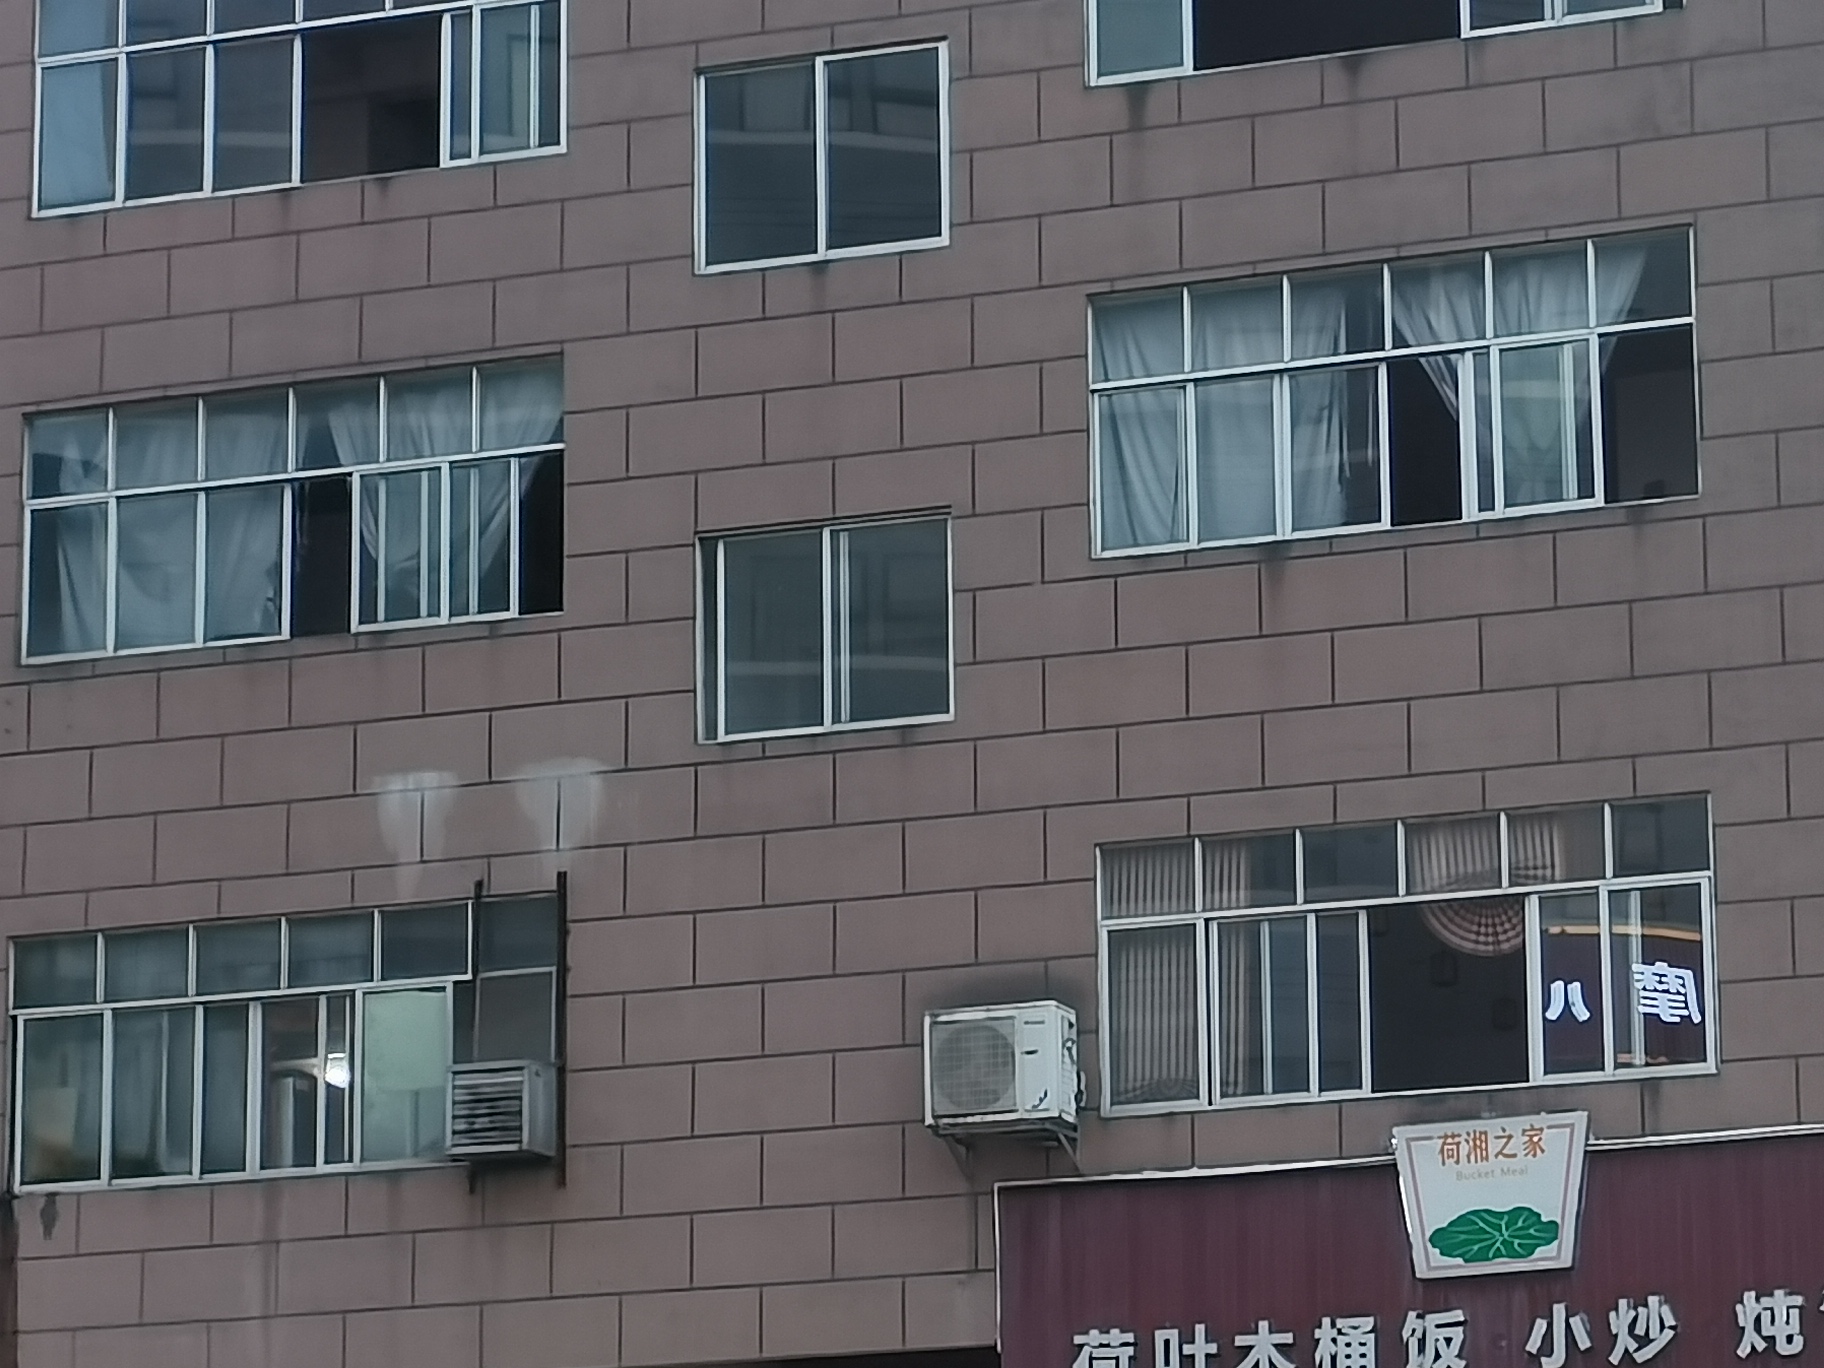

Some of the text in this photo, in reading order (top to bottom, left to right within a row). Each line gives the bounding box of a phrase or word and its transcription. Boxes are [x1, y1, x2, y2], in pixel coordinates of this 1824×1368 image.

[1437, 1123, 1547, 1167] 荷湘之家
[1455, 1164, 1529, 1182] Bucket Meal
